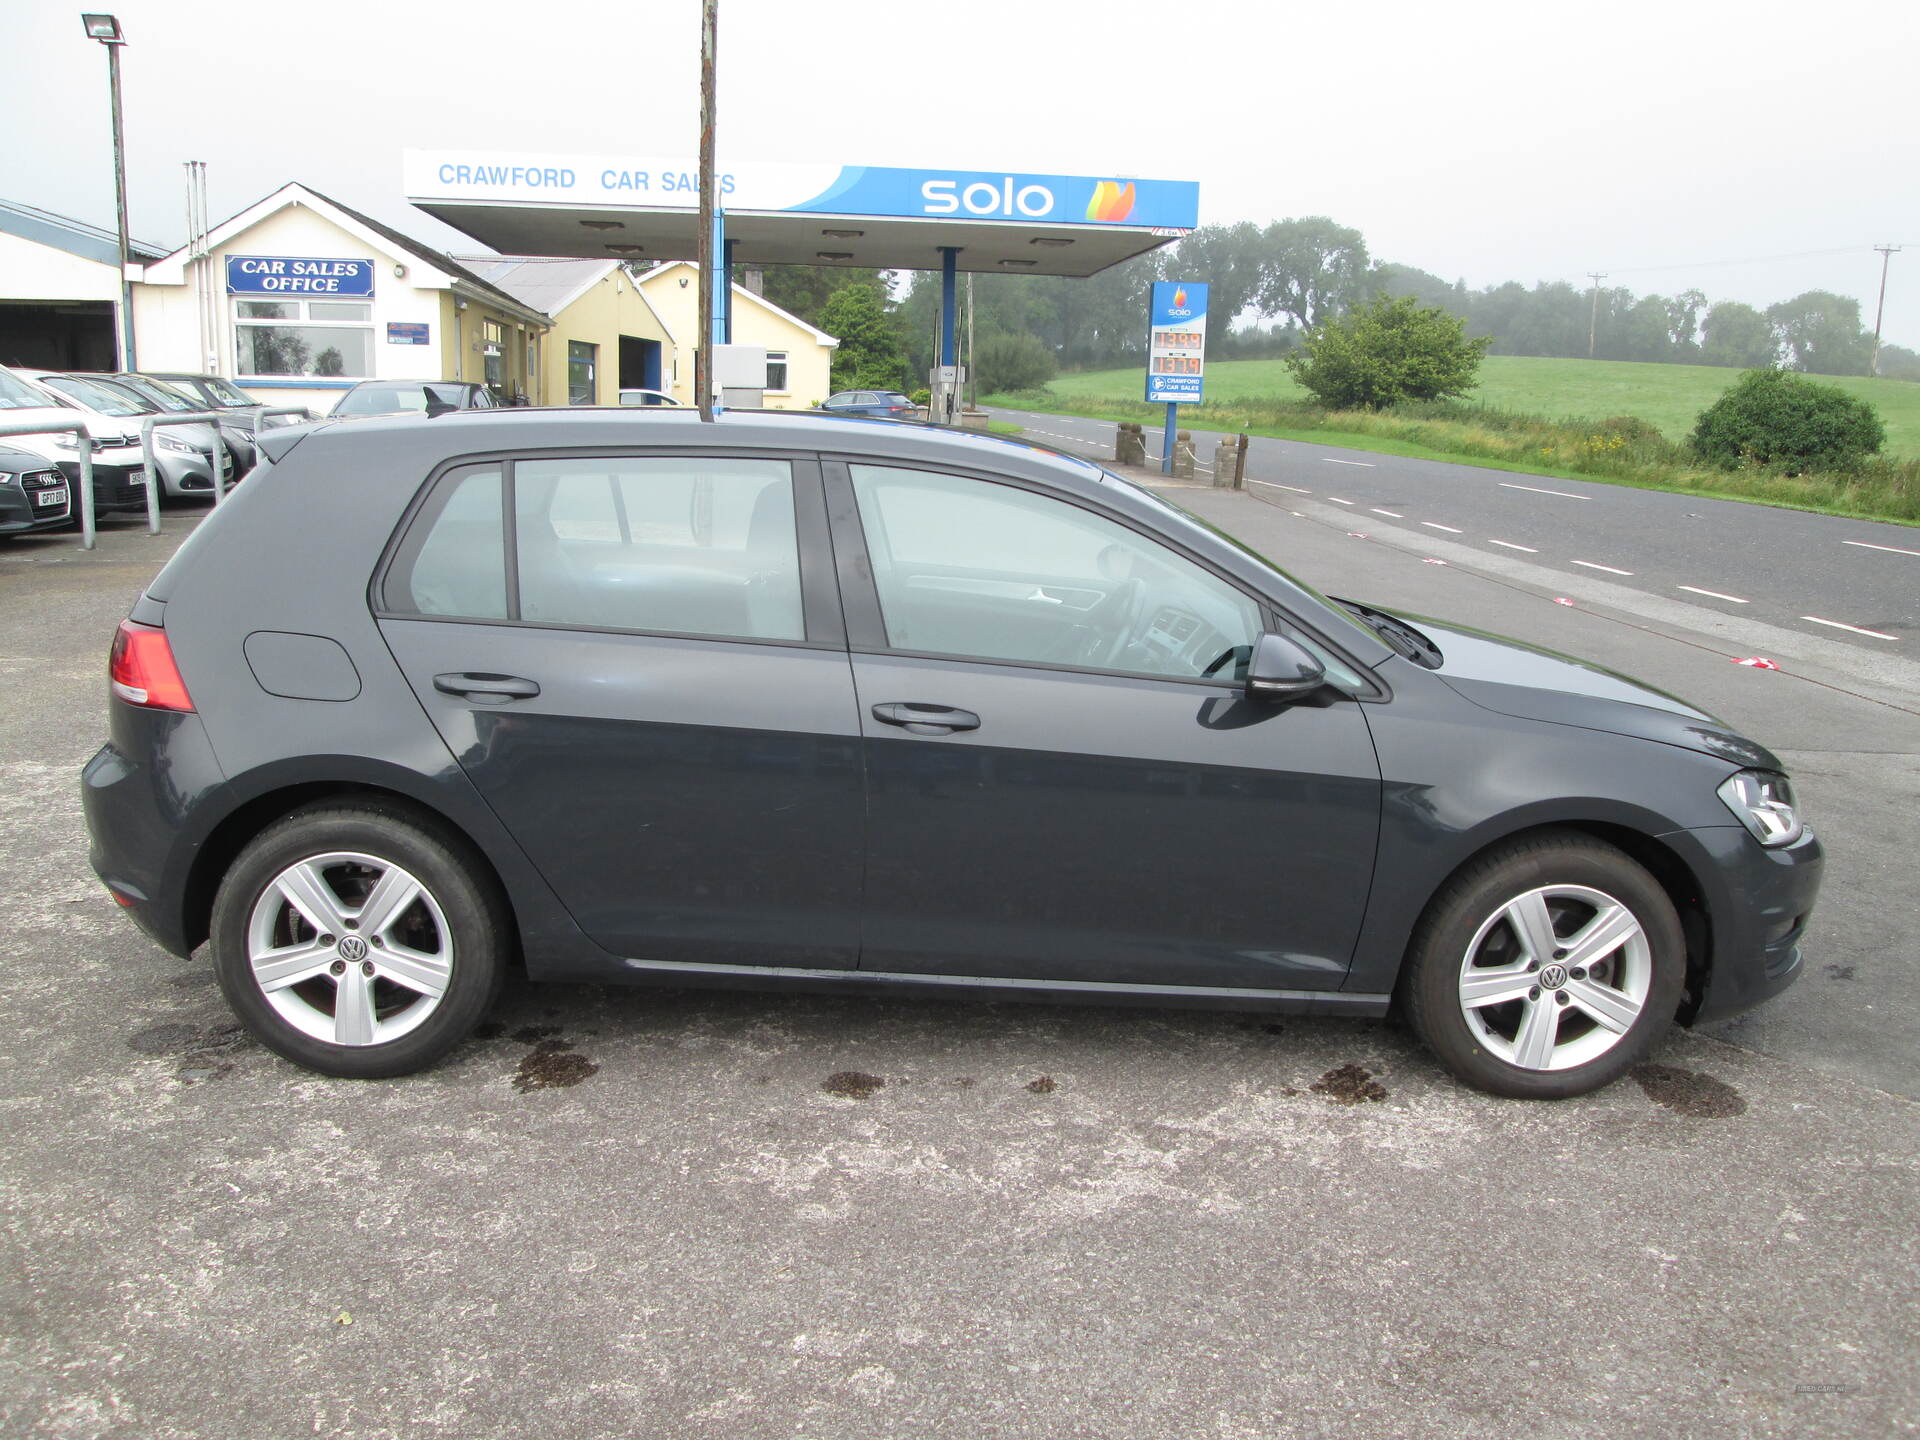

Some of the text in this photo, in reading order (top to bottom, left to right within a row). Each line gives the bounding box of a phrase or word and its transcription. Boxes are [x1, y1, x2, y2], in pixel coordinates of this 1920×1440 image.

[438, 164, 736, 193] CRAWFORD CAR SALS
[921, 177, 1054, 217] solo
[241, 260, 359, 277] CAR SALES
[262, 277, 340, 292] OFFICE
